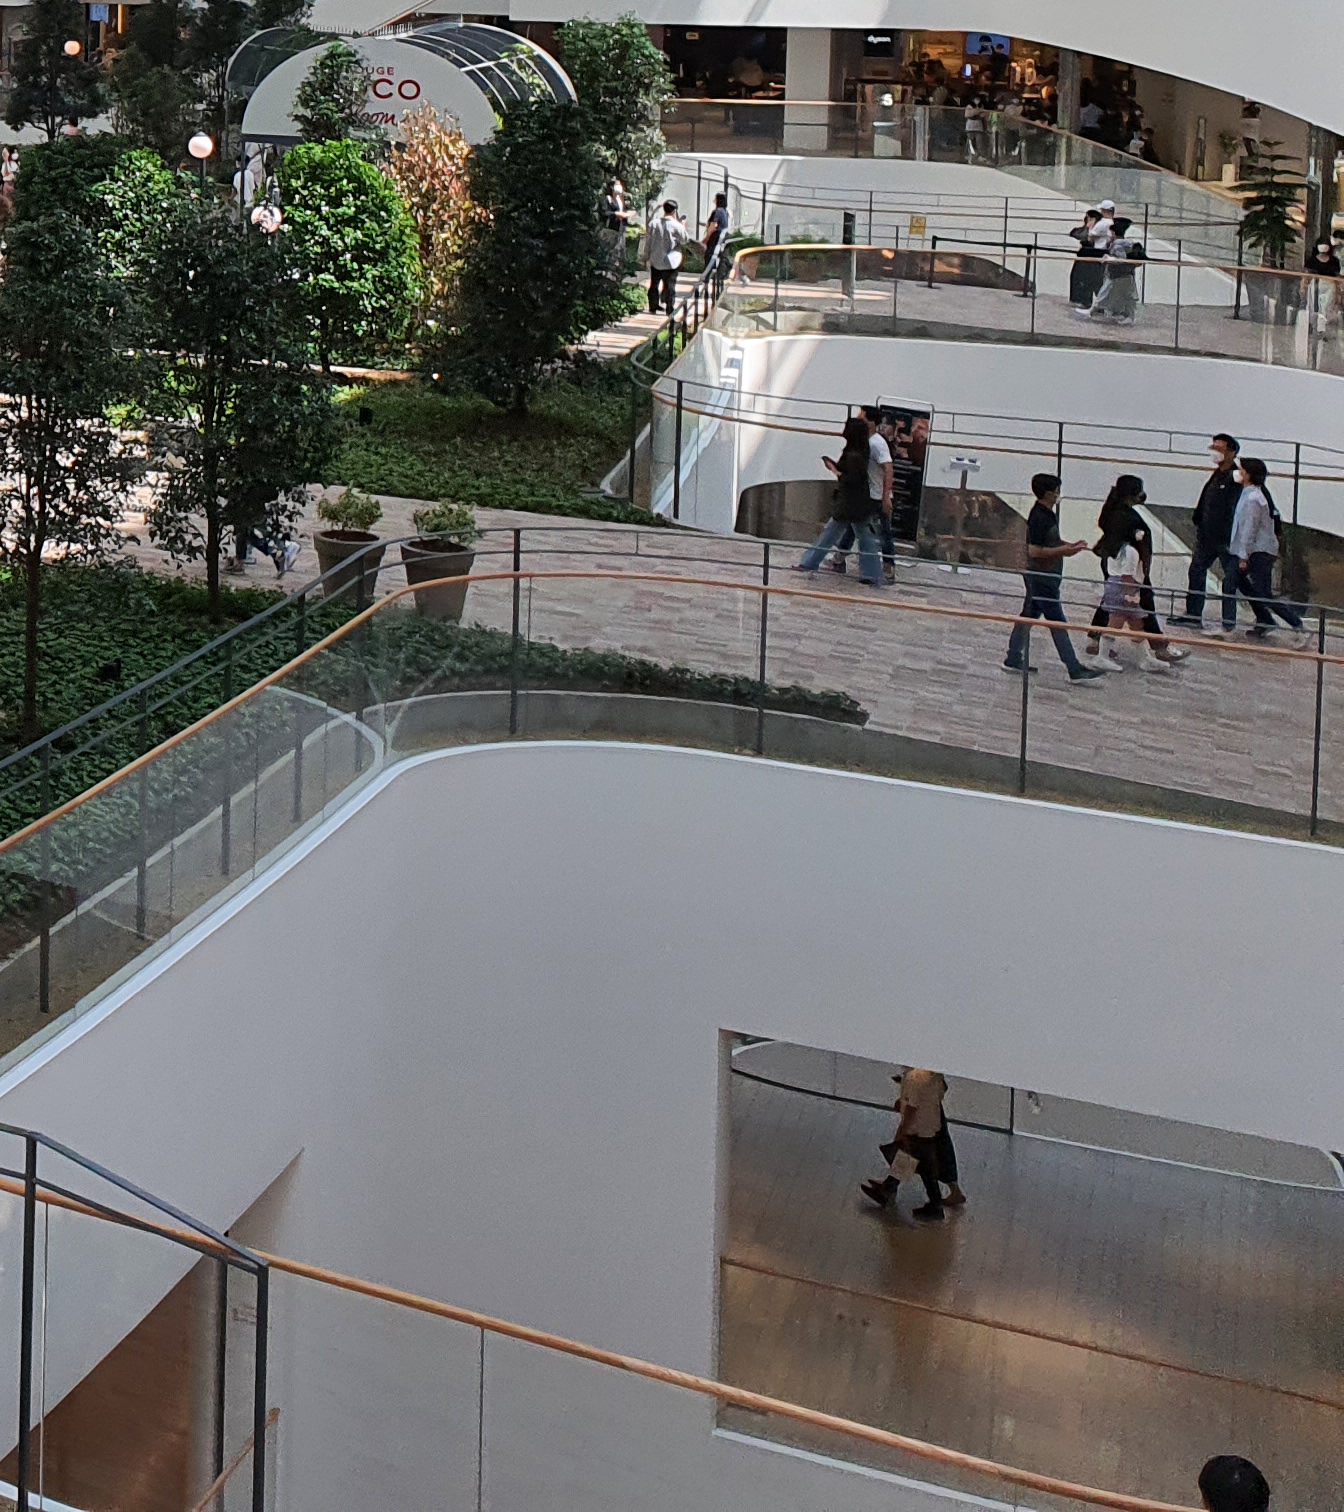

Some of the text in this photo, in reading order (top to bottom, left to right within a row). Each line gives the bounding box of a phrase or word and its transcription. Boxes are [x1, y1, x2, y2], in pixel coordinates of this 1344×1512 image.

[351, 66, 394, 75] OUGE
[372, 78, 421, 100] CO
[354, 107, 398, 127] loom
